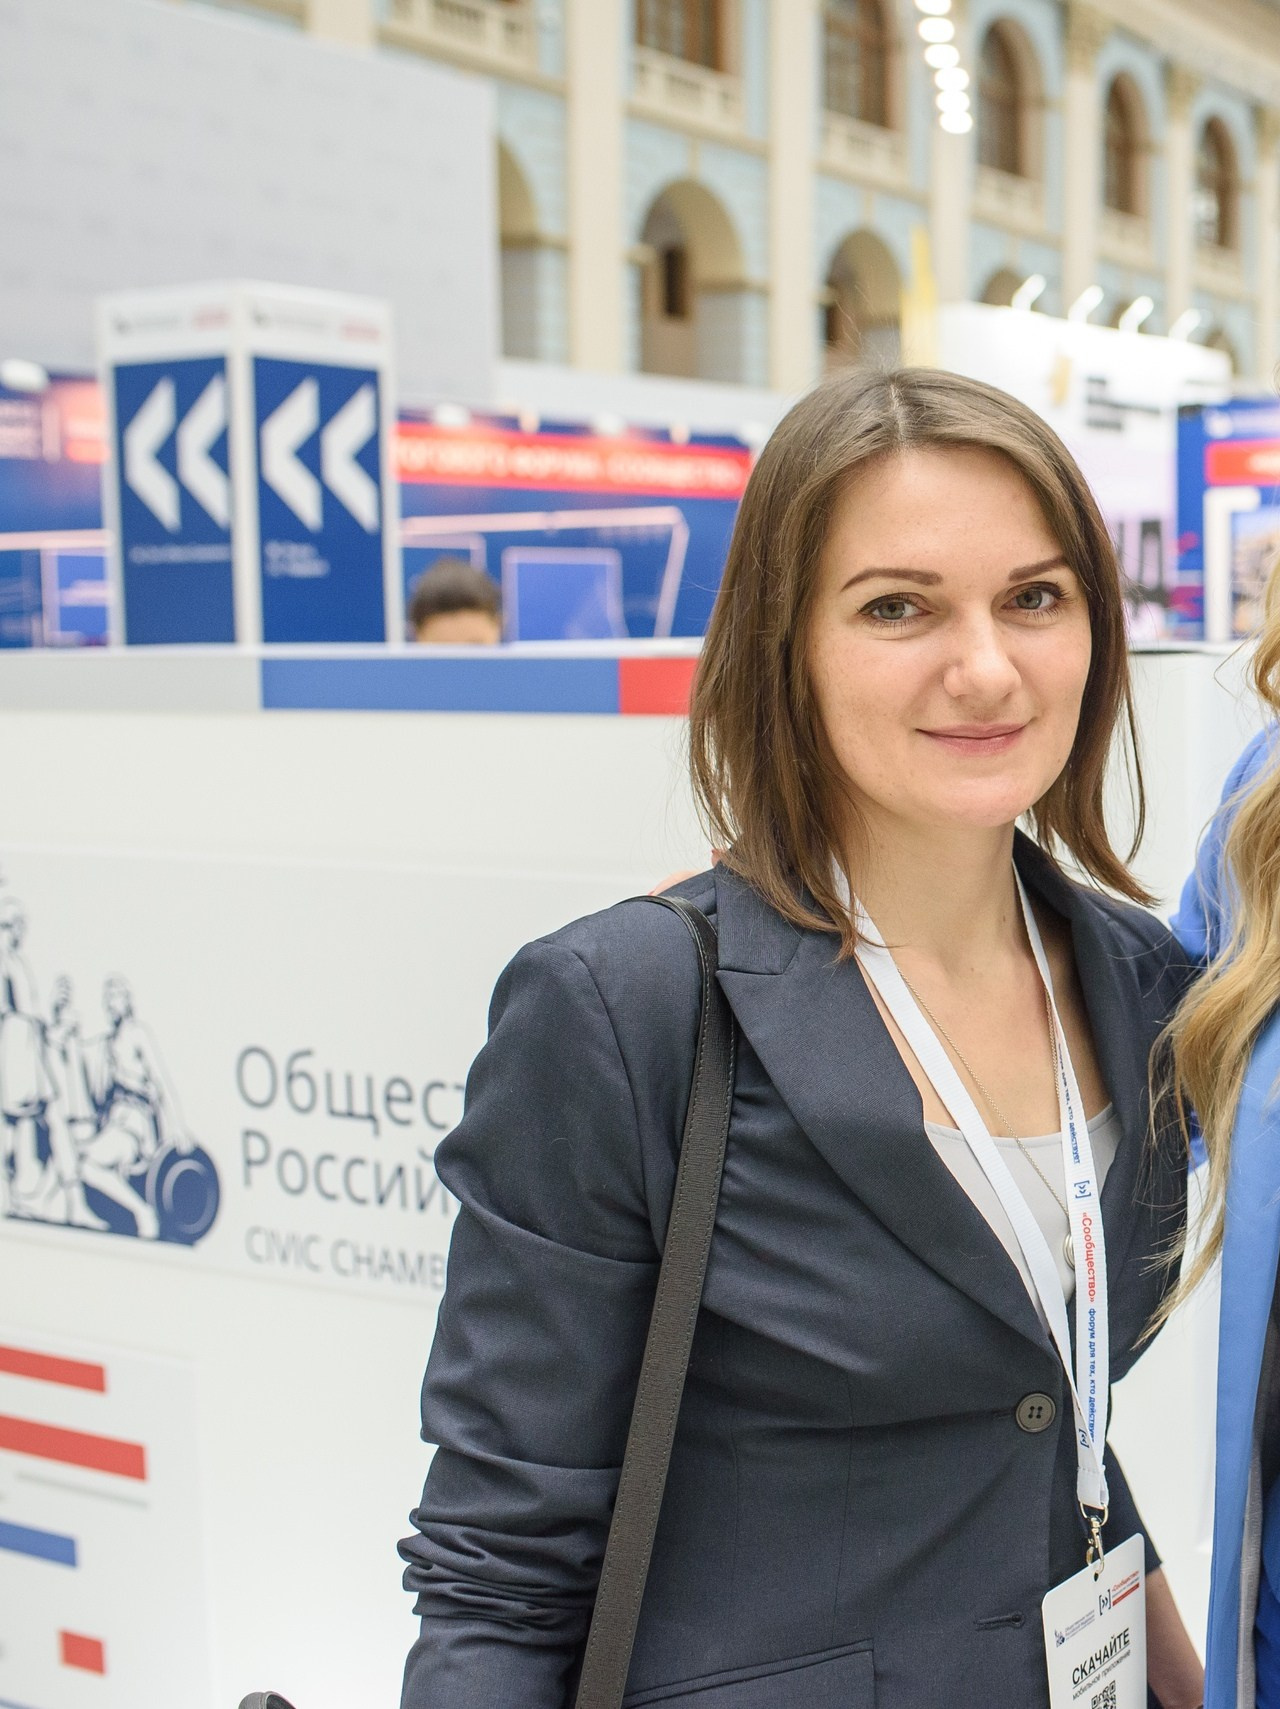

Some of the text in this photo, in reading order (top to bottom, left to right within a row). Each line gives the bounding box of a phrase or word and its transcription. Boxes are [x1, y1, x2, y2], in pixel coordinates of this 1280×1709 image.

[245, 1225, 322, 1273] CIVIC
[1081, 1212, 1096, 1303] «Сообщество»
[1088, 1308, 1096, 1339] форум
[1072, 1627, 1130, 1685] СКАЧАЙТЕ
[1073, 1673, 1101, 1701] мобильное
